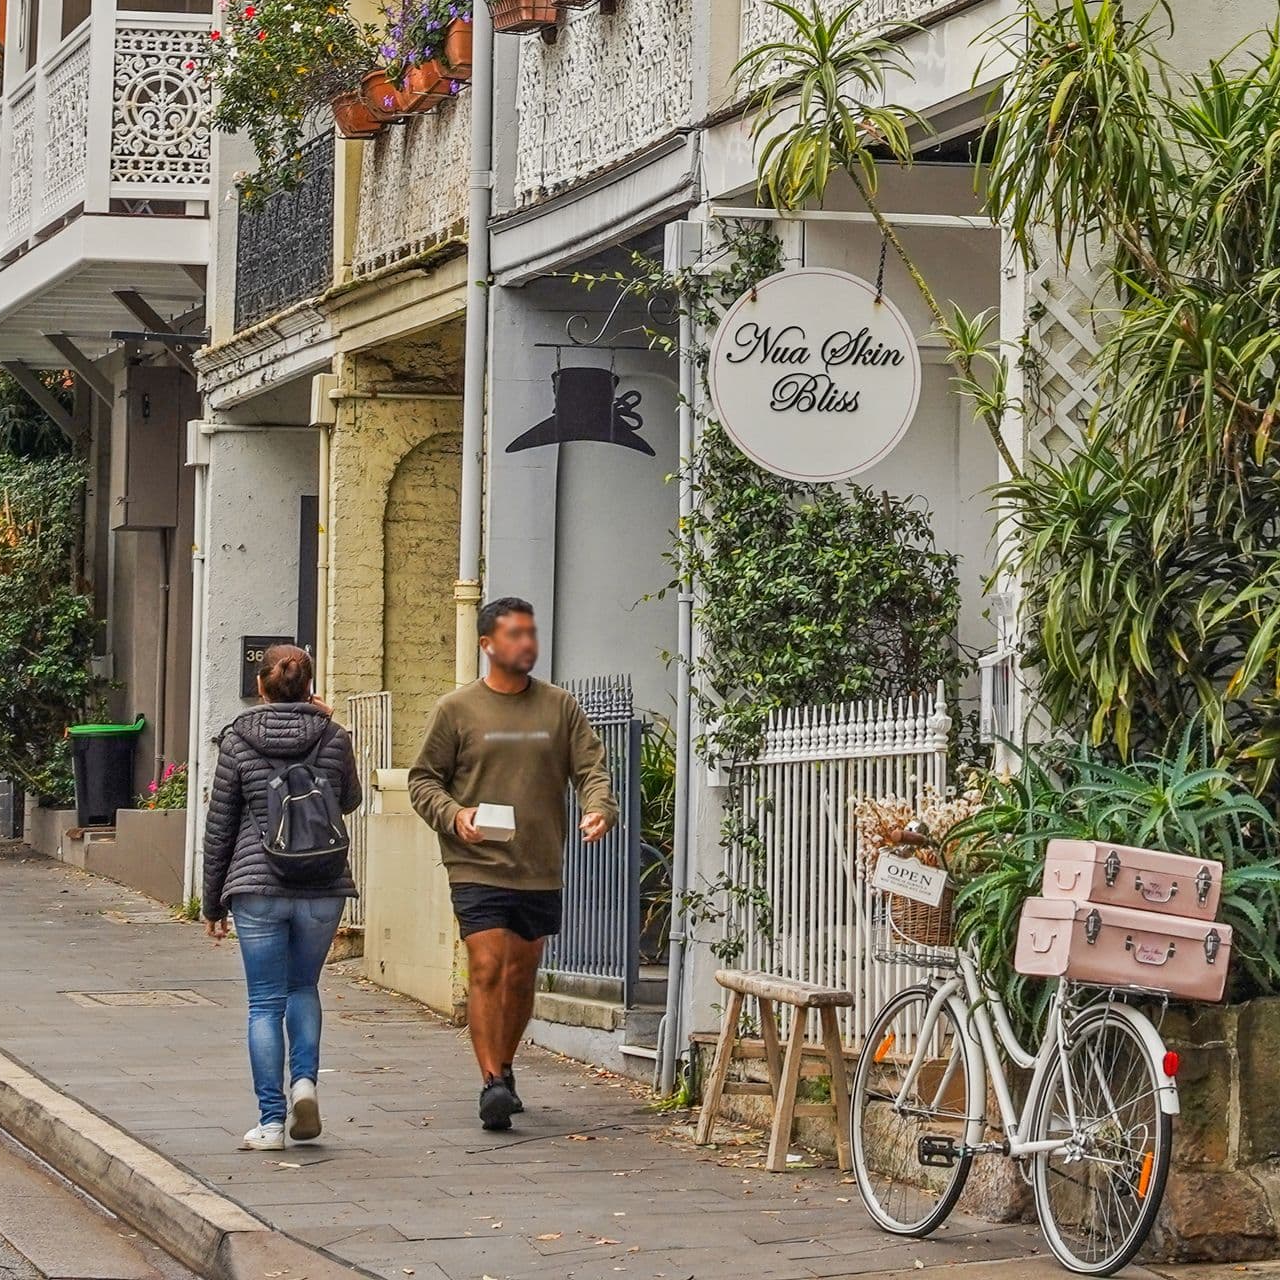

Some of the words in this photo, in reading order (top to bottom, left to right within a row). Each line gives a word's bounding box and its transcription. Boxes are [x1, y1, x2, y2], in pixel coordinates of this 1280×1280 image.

[726, 322, 810, 364] Nua
[821, 326, 904, 373] Skin
[770, 372, 860, 412] Bliss
[246, 650, 265, 662] 36
[887, 864, 933, 886] OPEN
